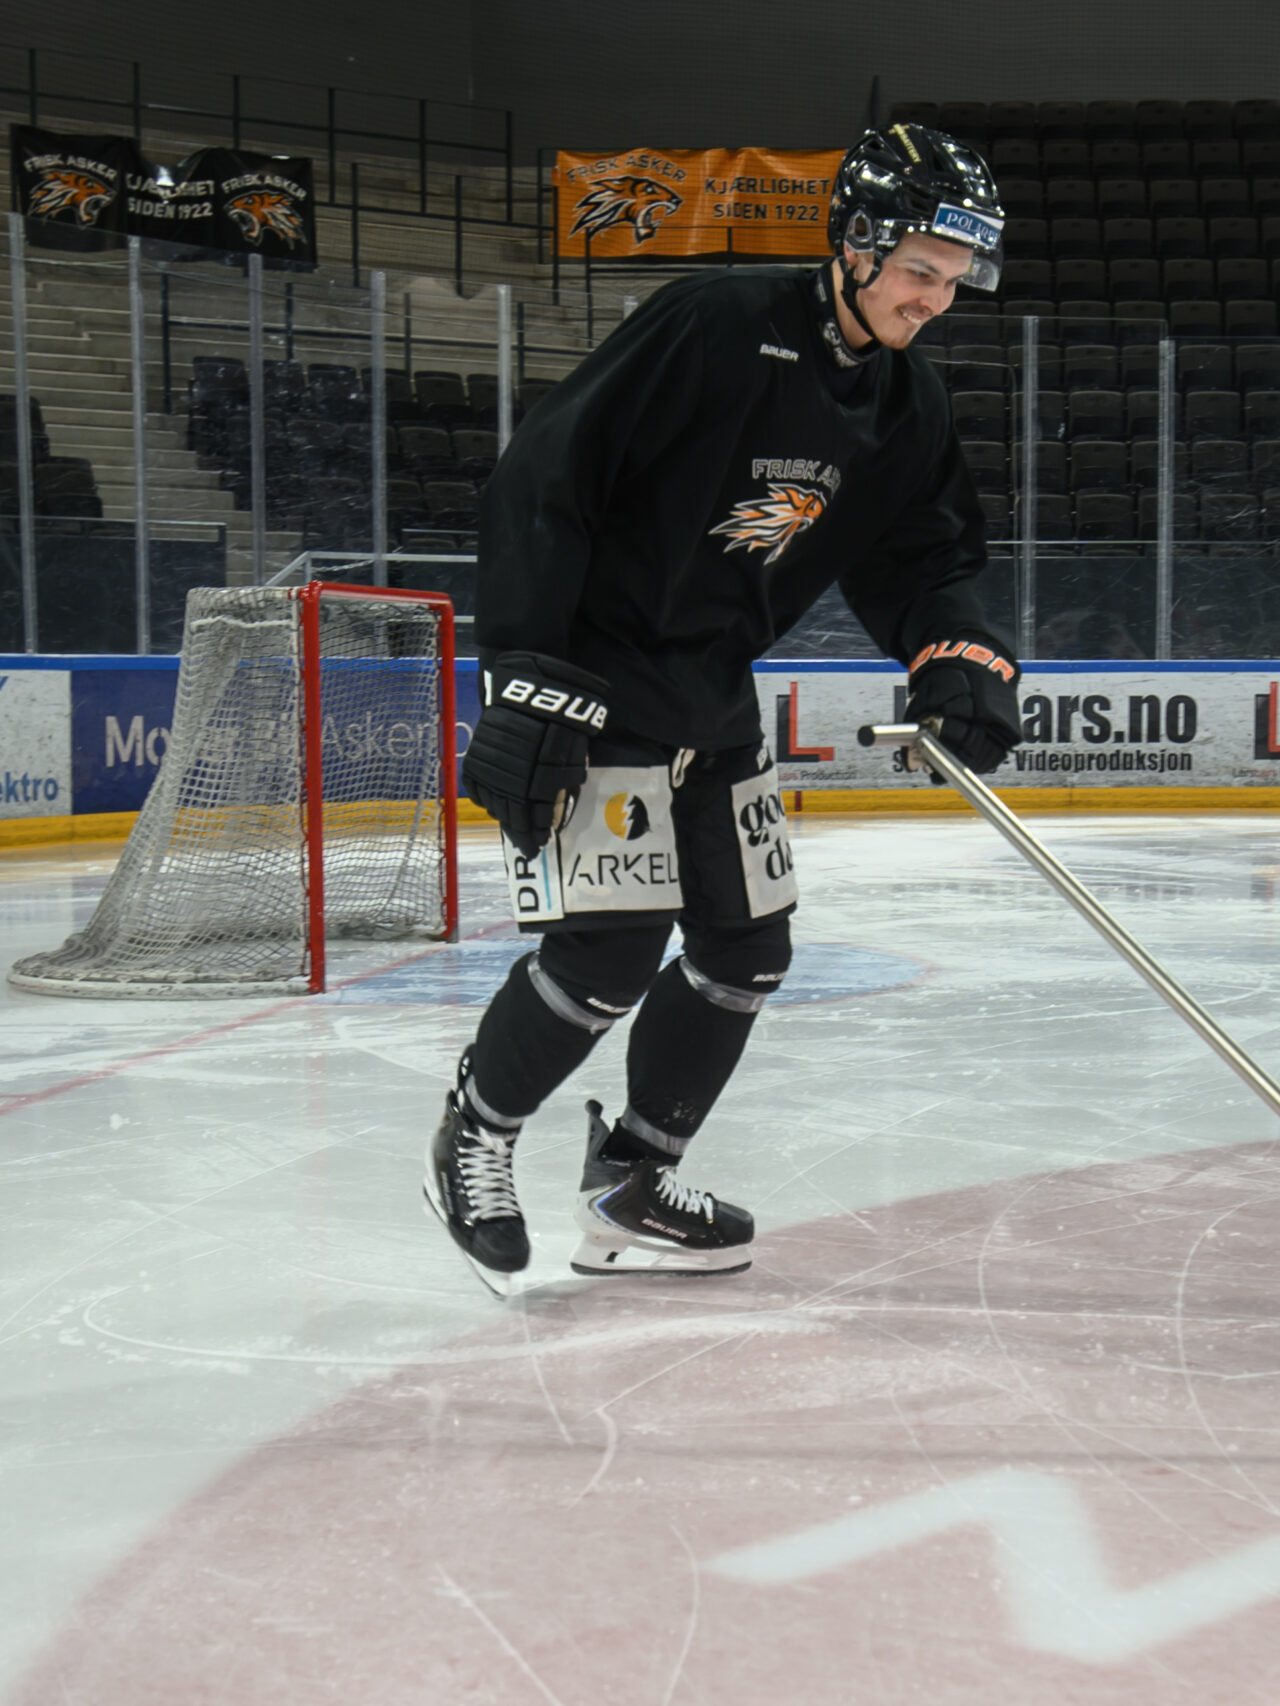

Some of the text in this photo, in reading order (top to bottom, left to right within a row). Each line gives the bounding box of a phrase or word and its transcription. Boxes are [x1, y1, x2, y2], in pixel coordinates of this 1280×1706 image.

[66, 155, 118, 181] ASKER
[565, 155, 687, 184] FRISK ASKER
[704, 177, 830, 194] KJÆRLIGHET
[128, 197, 214, 219] SIDEN 1922
[713, 203, 820, 221] SIDEN 1922
[760, 343, 799, 362] BAUER
[752, 458, 821, 480] FRISK
[908, 640, 1015, 683] AUER
[501, 679, 608, 730] BAU
[1015, 750, 1193, 773] Videoproduksjon
[567, 853, 678, 886] ARKEL
[641, 1218, 688, 1239] BAUER
